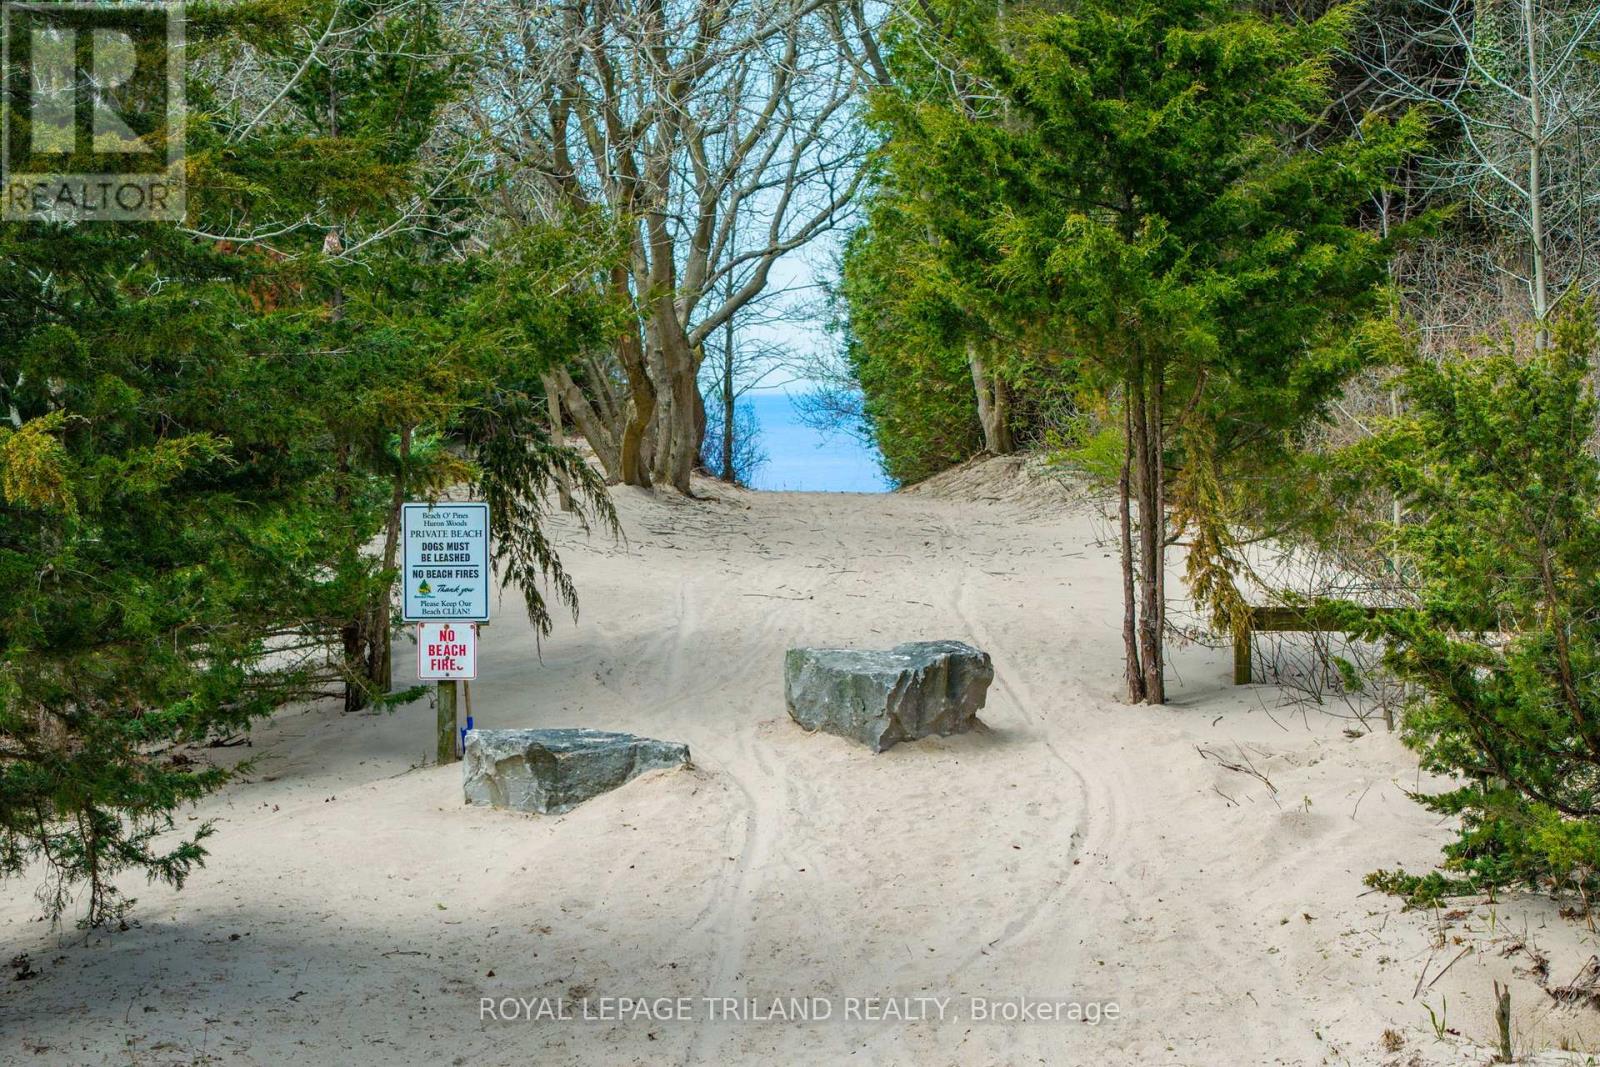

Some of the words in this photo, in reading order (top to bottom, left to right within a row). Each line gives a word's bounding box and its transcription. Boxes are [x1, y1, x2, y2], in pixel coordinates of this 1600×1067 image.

[410, 530, 449, 538] PRIVATE
[451, 530, 483, 538] BEACH
[422, 542, 444, 551] DOGS
[446, 542, 470, 551] MUST
[421, 553, 432, 562] BE
[434, 553, 471, 562] LEASHED
[412, 570, 424, 578] NO
[426, 570, 453, 578] BEACH
[455, 570, 479, 578] FIRES
[436, 584, 460, 593] Thank
[457, 587, 475, 597] you
[441, 600, 457, 608] Keep
[439, 630, 455, 642] NO
[428, 644, 466, 656] BEACH
